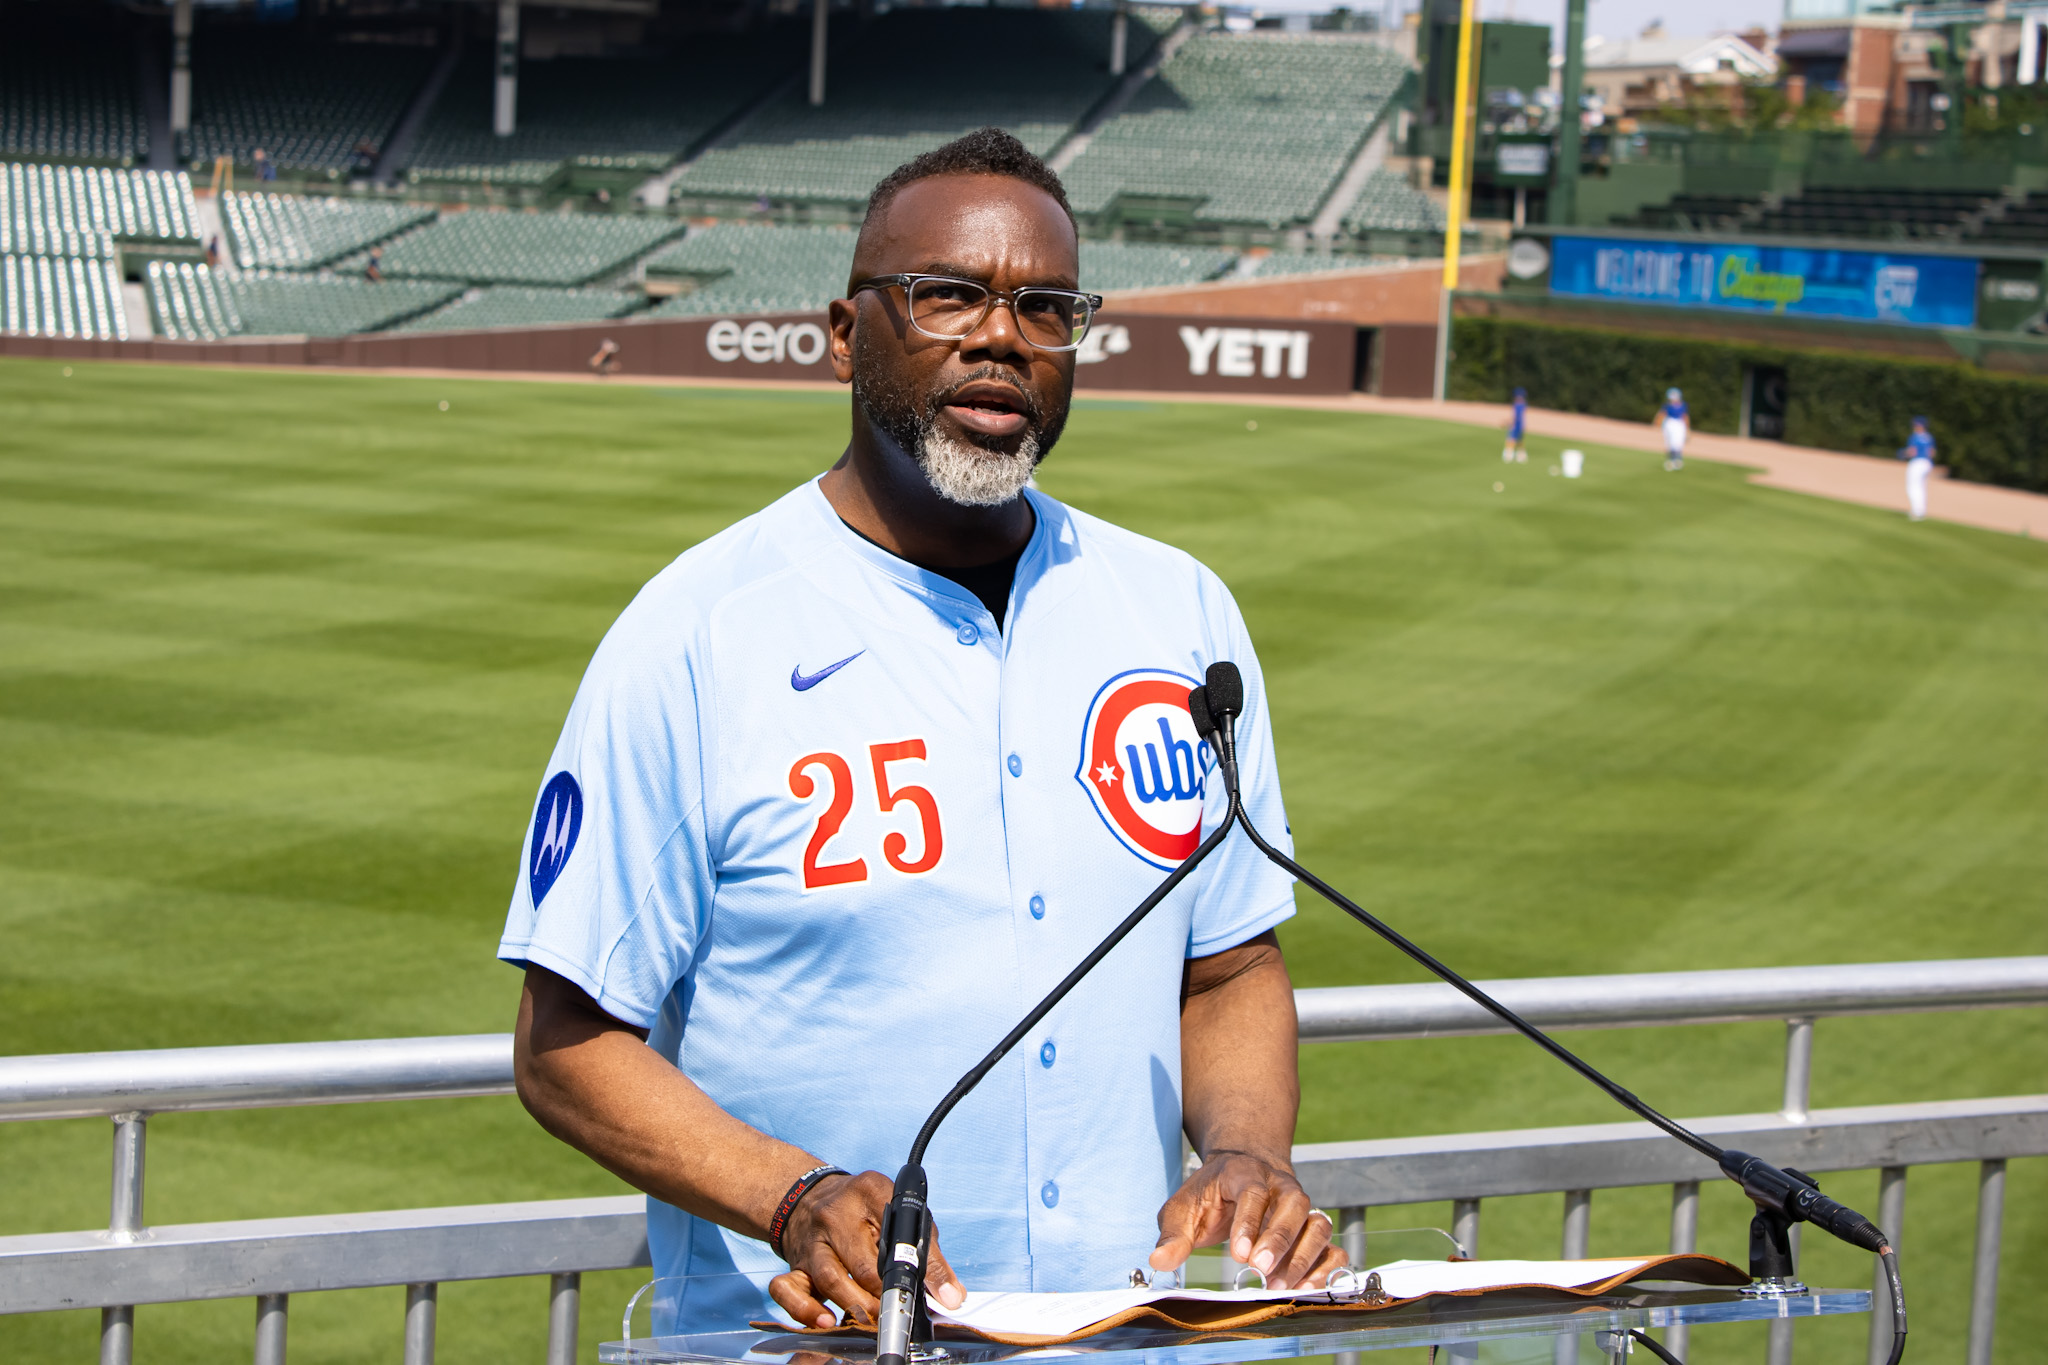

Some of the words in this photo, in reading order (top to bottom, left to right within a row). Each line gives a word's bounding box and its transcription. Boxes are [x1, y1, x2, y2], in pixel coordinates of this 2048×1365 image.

[706, 320, 827, 365] eero
[1178, 326, 1310, 379] YETI
[786, 737, 944, 890] 25
[788, 1182, 806, 1203] God
[902, 1196, 923, 1206] SHUR
